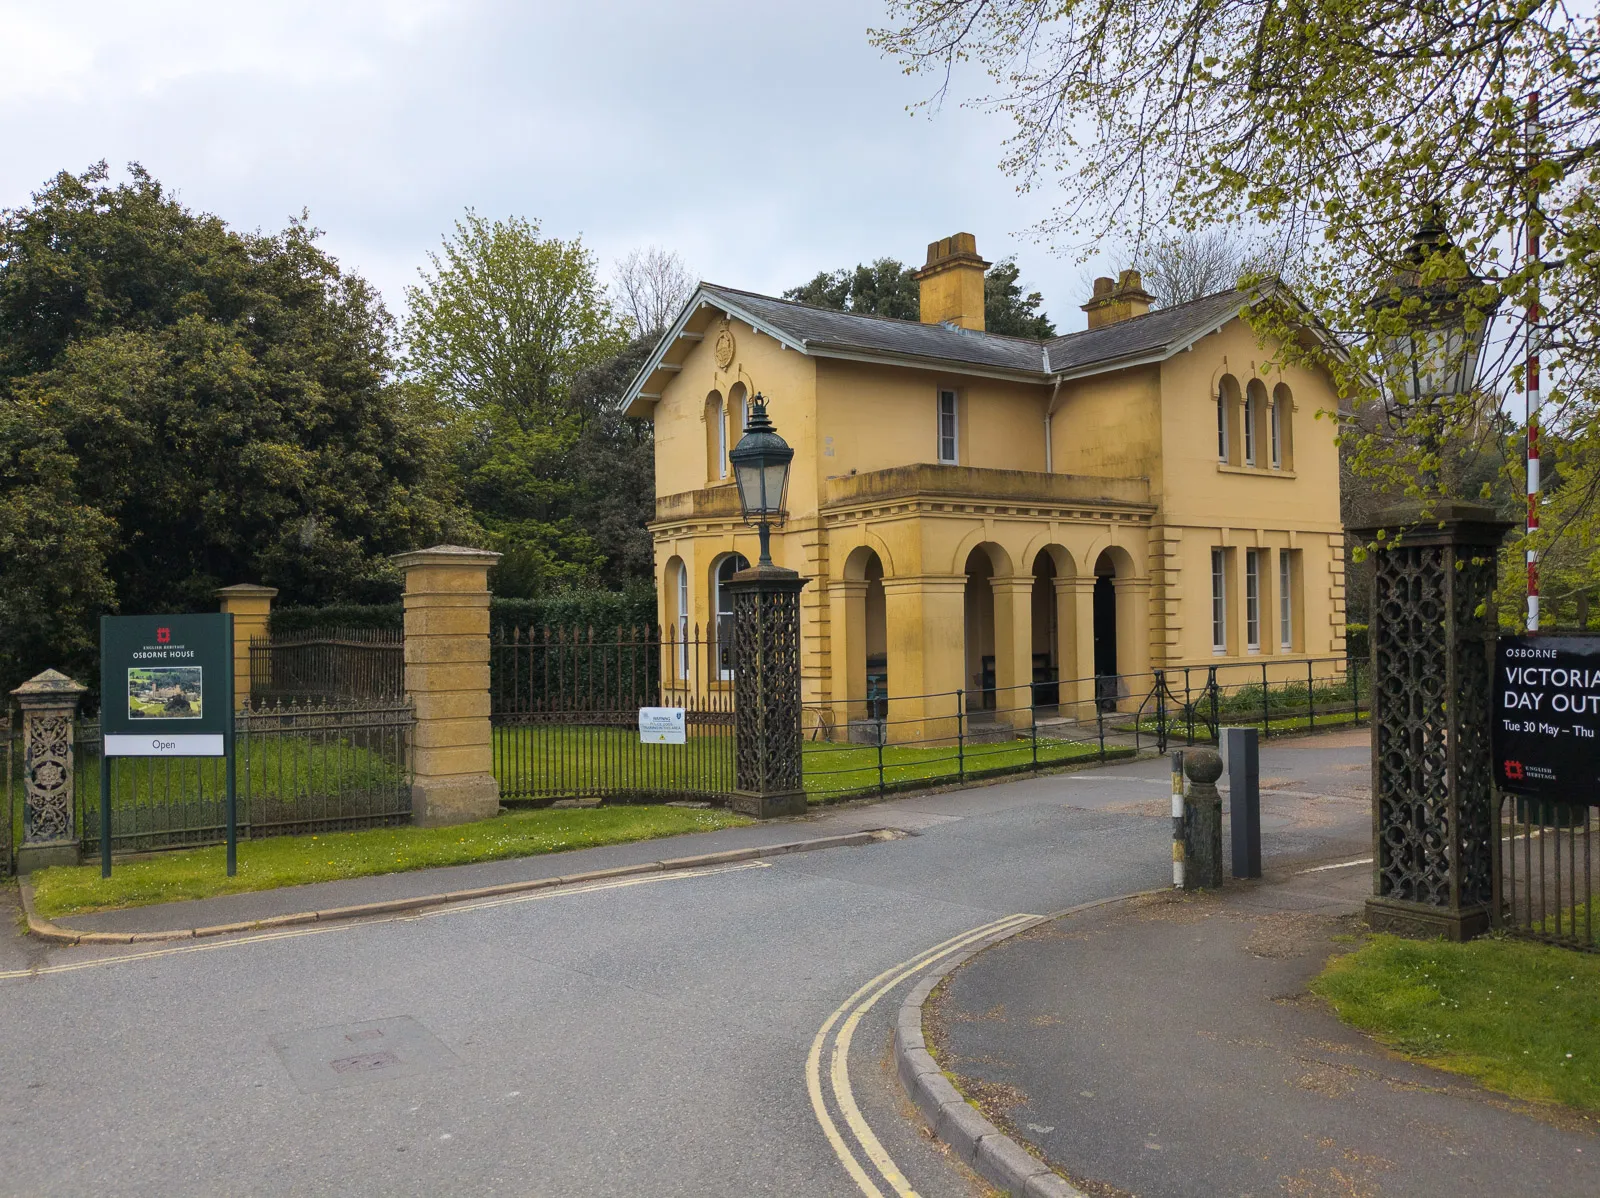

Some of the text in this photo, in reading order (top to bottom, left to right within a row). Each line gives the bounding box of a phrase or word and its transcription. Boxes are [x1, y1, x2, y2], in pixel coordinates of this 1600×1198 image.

[1506, 648, 1557, 658] OSBORNE
[1506, 666, 1600, 688] VICTORIA
[1504, 691, 1600, 714] DAY OUT
[1502, 720, 1520, 731] Tue
[1523, 722, 1536, 732] 30
[1538, 722, 1559, 738] May
[1572, 726, 1594, 737] Thu
[152, 740, 175, 751] Open
